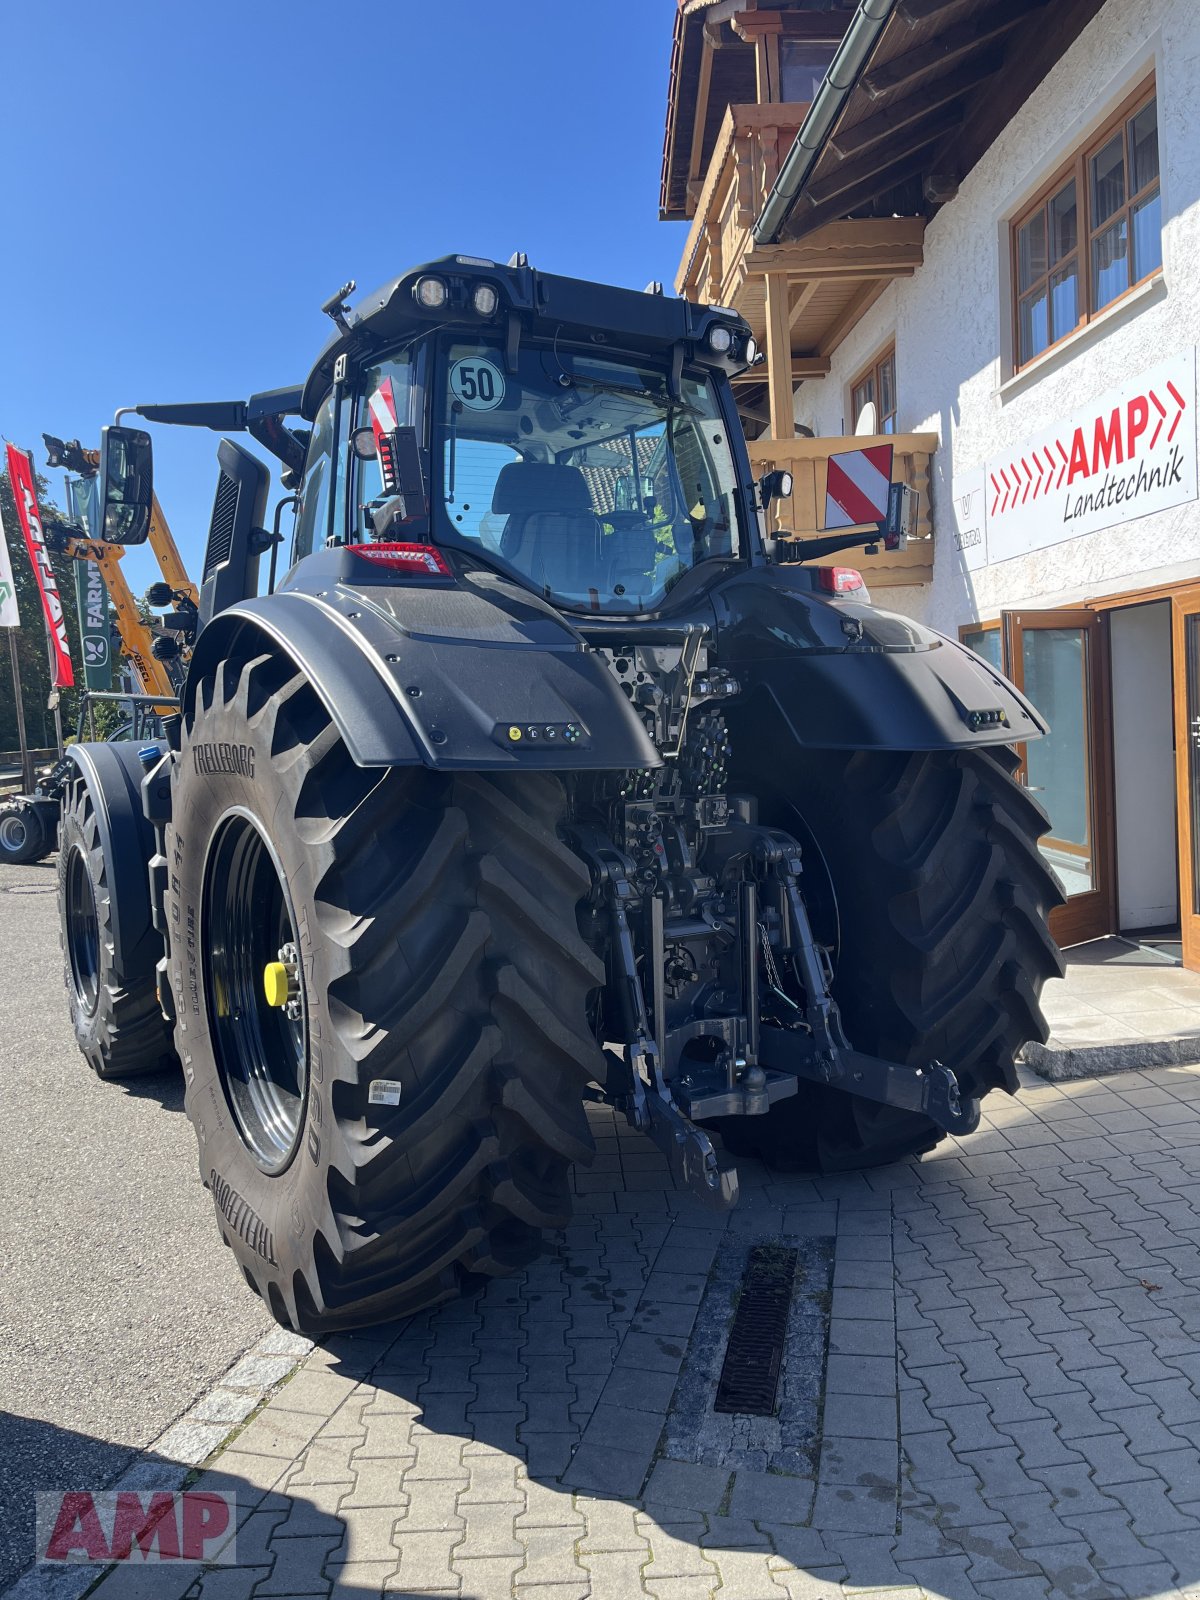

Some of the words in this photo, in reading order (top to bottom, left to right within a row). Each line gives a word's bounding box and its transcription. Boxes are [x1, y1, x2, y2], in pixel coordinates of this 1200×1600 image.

[459, 366, 495, 402] 50
[1067, 395, 1149, 486] AMP
[1063, 444, 1185, 523] Landtechnik
[953, 527, 981, 552] VALTRA
[86, 558, 105, 628] FARMT
[192, 742, 256, 780] TRELLEBORG
[210, 1167, 279, 1271] TRELLEBORG
